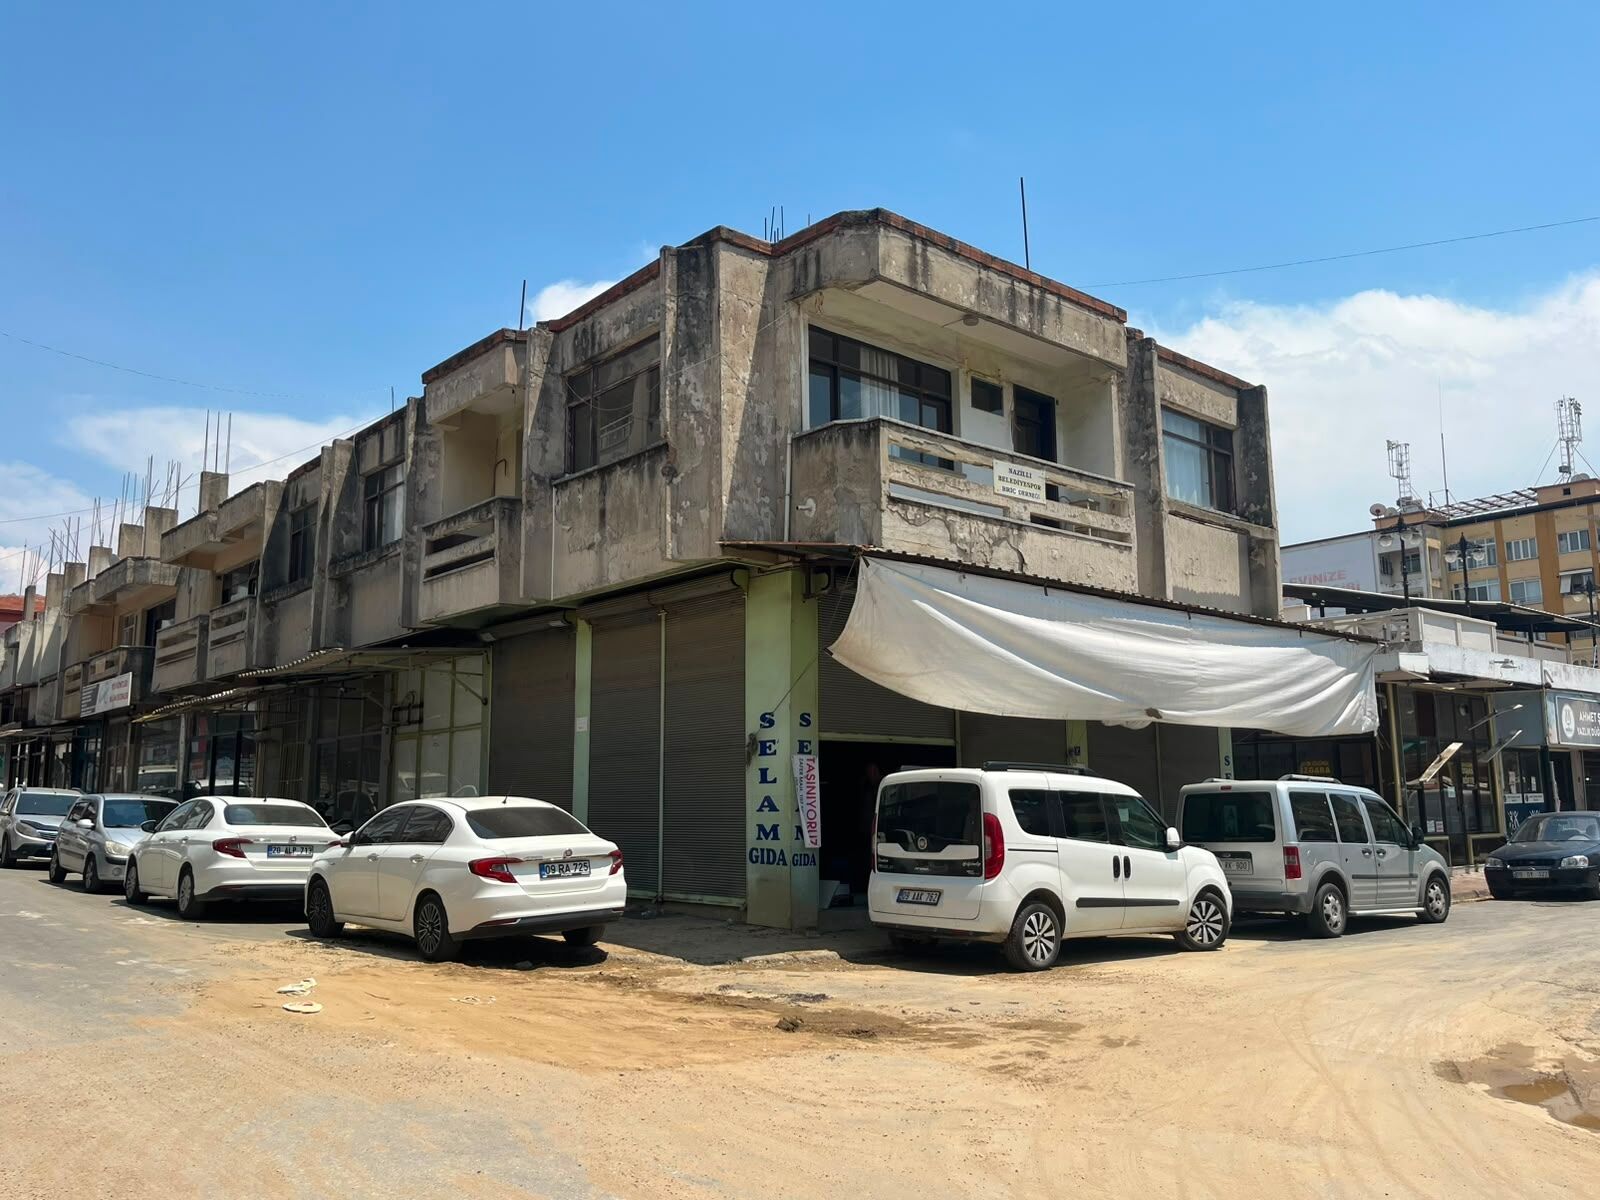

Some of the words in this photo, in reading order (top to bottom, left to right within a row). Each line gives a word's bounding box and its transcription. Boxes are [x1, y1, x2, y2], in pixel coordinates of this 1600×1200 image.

[284, 846, 297, 855] ALP
[748, 847, 788, 867] GIDA
[792, 852, 817, 867] GIDA
[545, 864, 556, 875] 09
[558, 863, 571, 874] RA
[572, 862, 589, 872] 725
